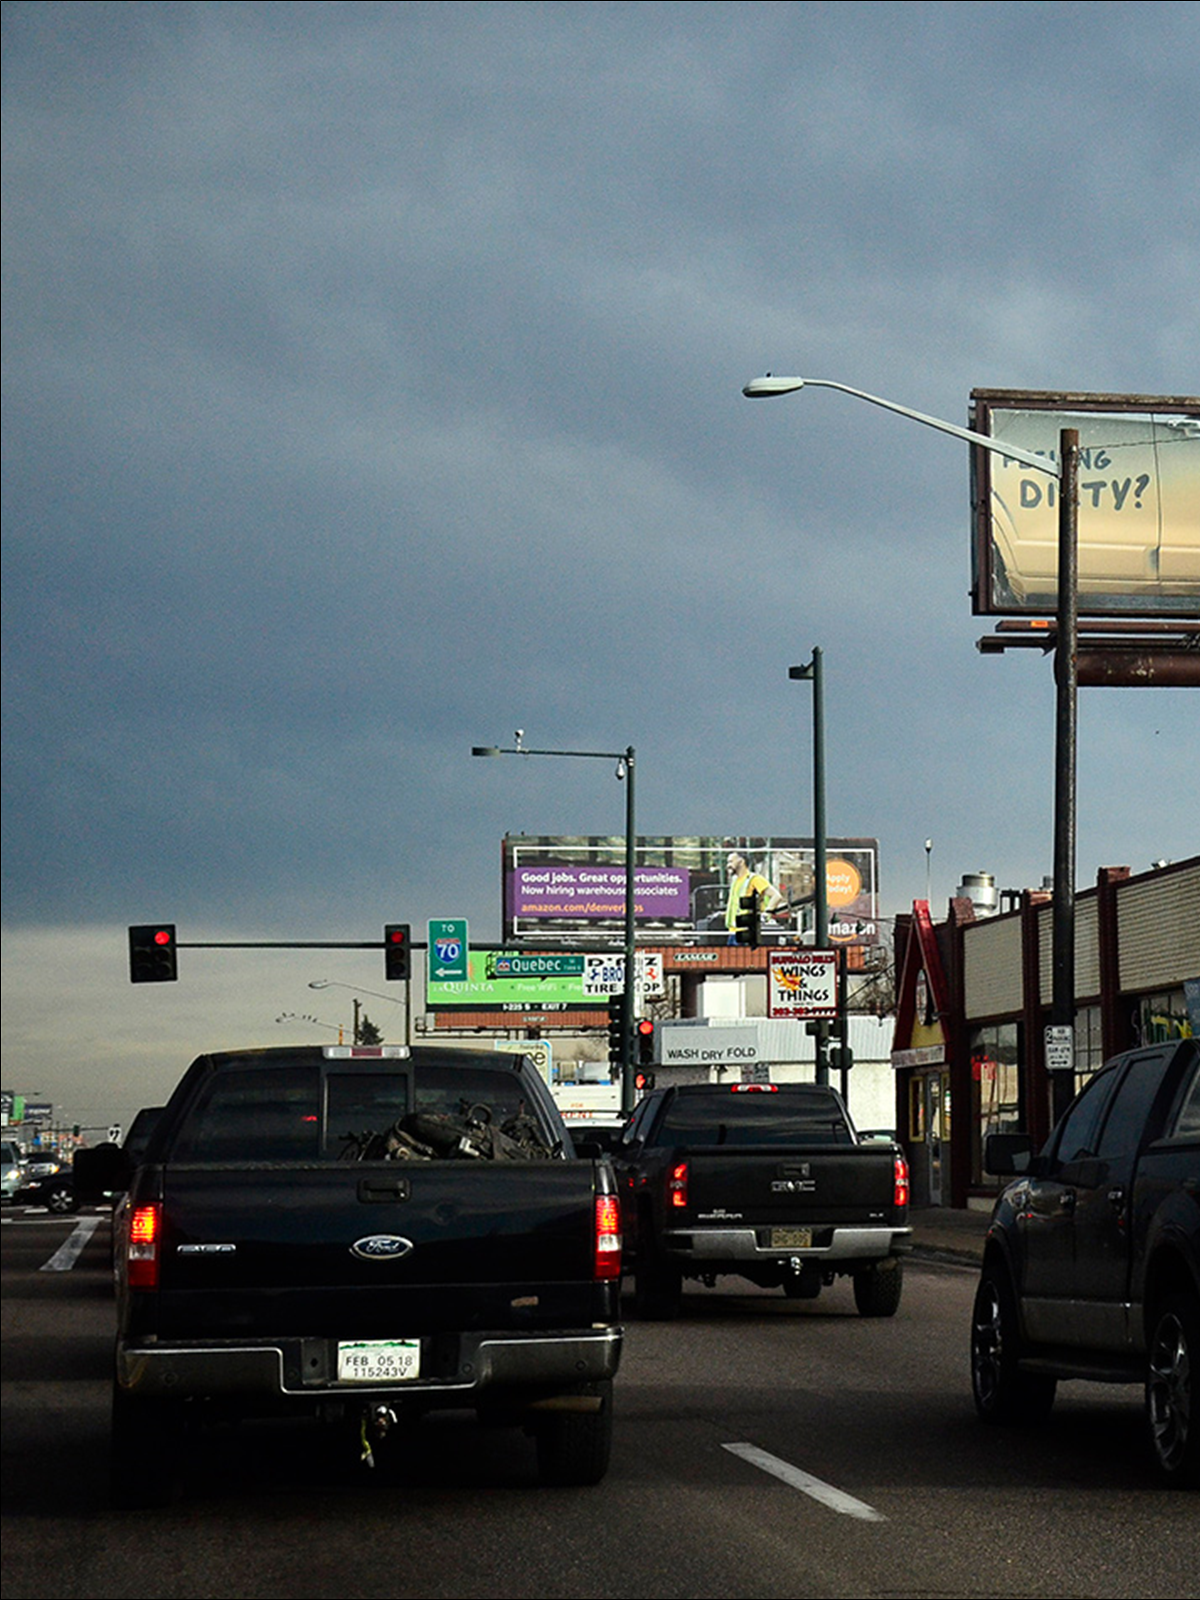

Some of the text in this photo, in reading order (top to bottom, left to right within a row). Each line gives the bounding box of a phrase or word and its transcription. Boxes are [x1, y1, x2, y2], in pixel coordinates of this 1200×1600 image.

[1020, 473, 1150, 511] DITY?
[521, 872, 683, 885] Good jobs. Great opprtunities.
[521, 886, 544, 895] Now
[546, 885, 575, 897] hiring
[441, 924, 455, 933] TO
[827, 923, 876, 935] mazon
[437, 943, 459, 959] 70
[511, 957, 561, 973] Quebec
[781, 965, 826, 977] WINGS
[585, 983, 617, 993] TIRE
[777, 989, 830, 1002] THINGS
[667, 1047, 757, 1061] WASH DRY FOLD
[345, 1355, 413, 1367] FEB 05 18
[353, 1367, 407, 1378] 115243V
